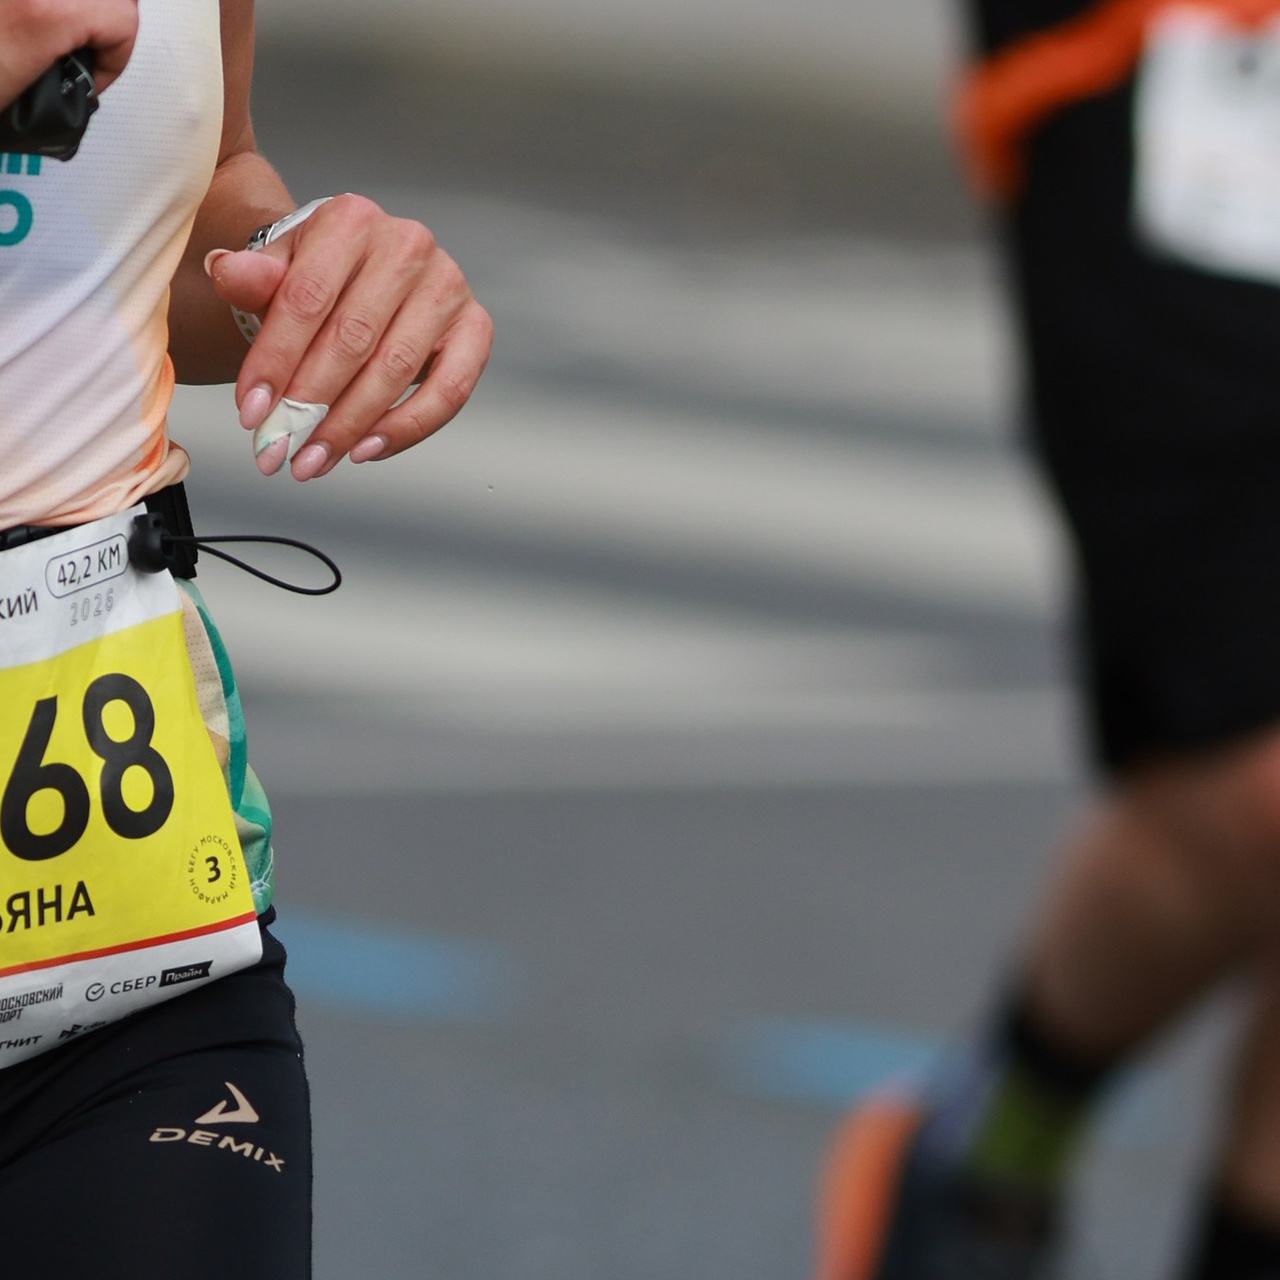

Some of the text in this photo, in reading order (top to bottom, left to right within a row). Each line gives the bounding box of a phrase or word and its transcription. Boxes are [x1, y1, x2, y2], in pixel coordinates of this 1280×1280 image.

[56, 555, 91, 587] 42,2
[205, 856, 221, 883] 3
[110, 968, 203, 995] СБЕР Прайм
[149, 1127, 285, 1173] DEMIX
